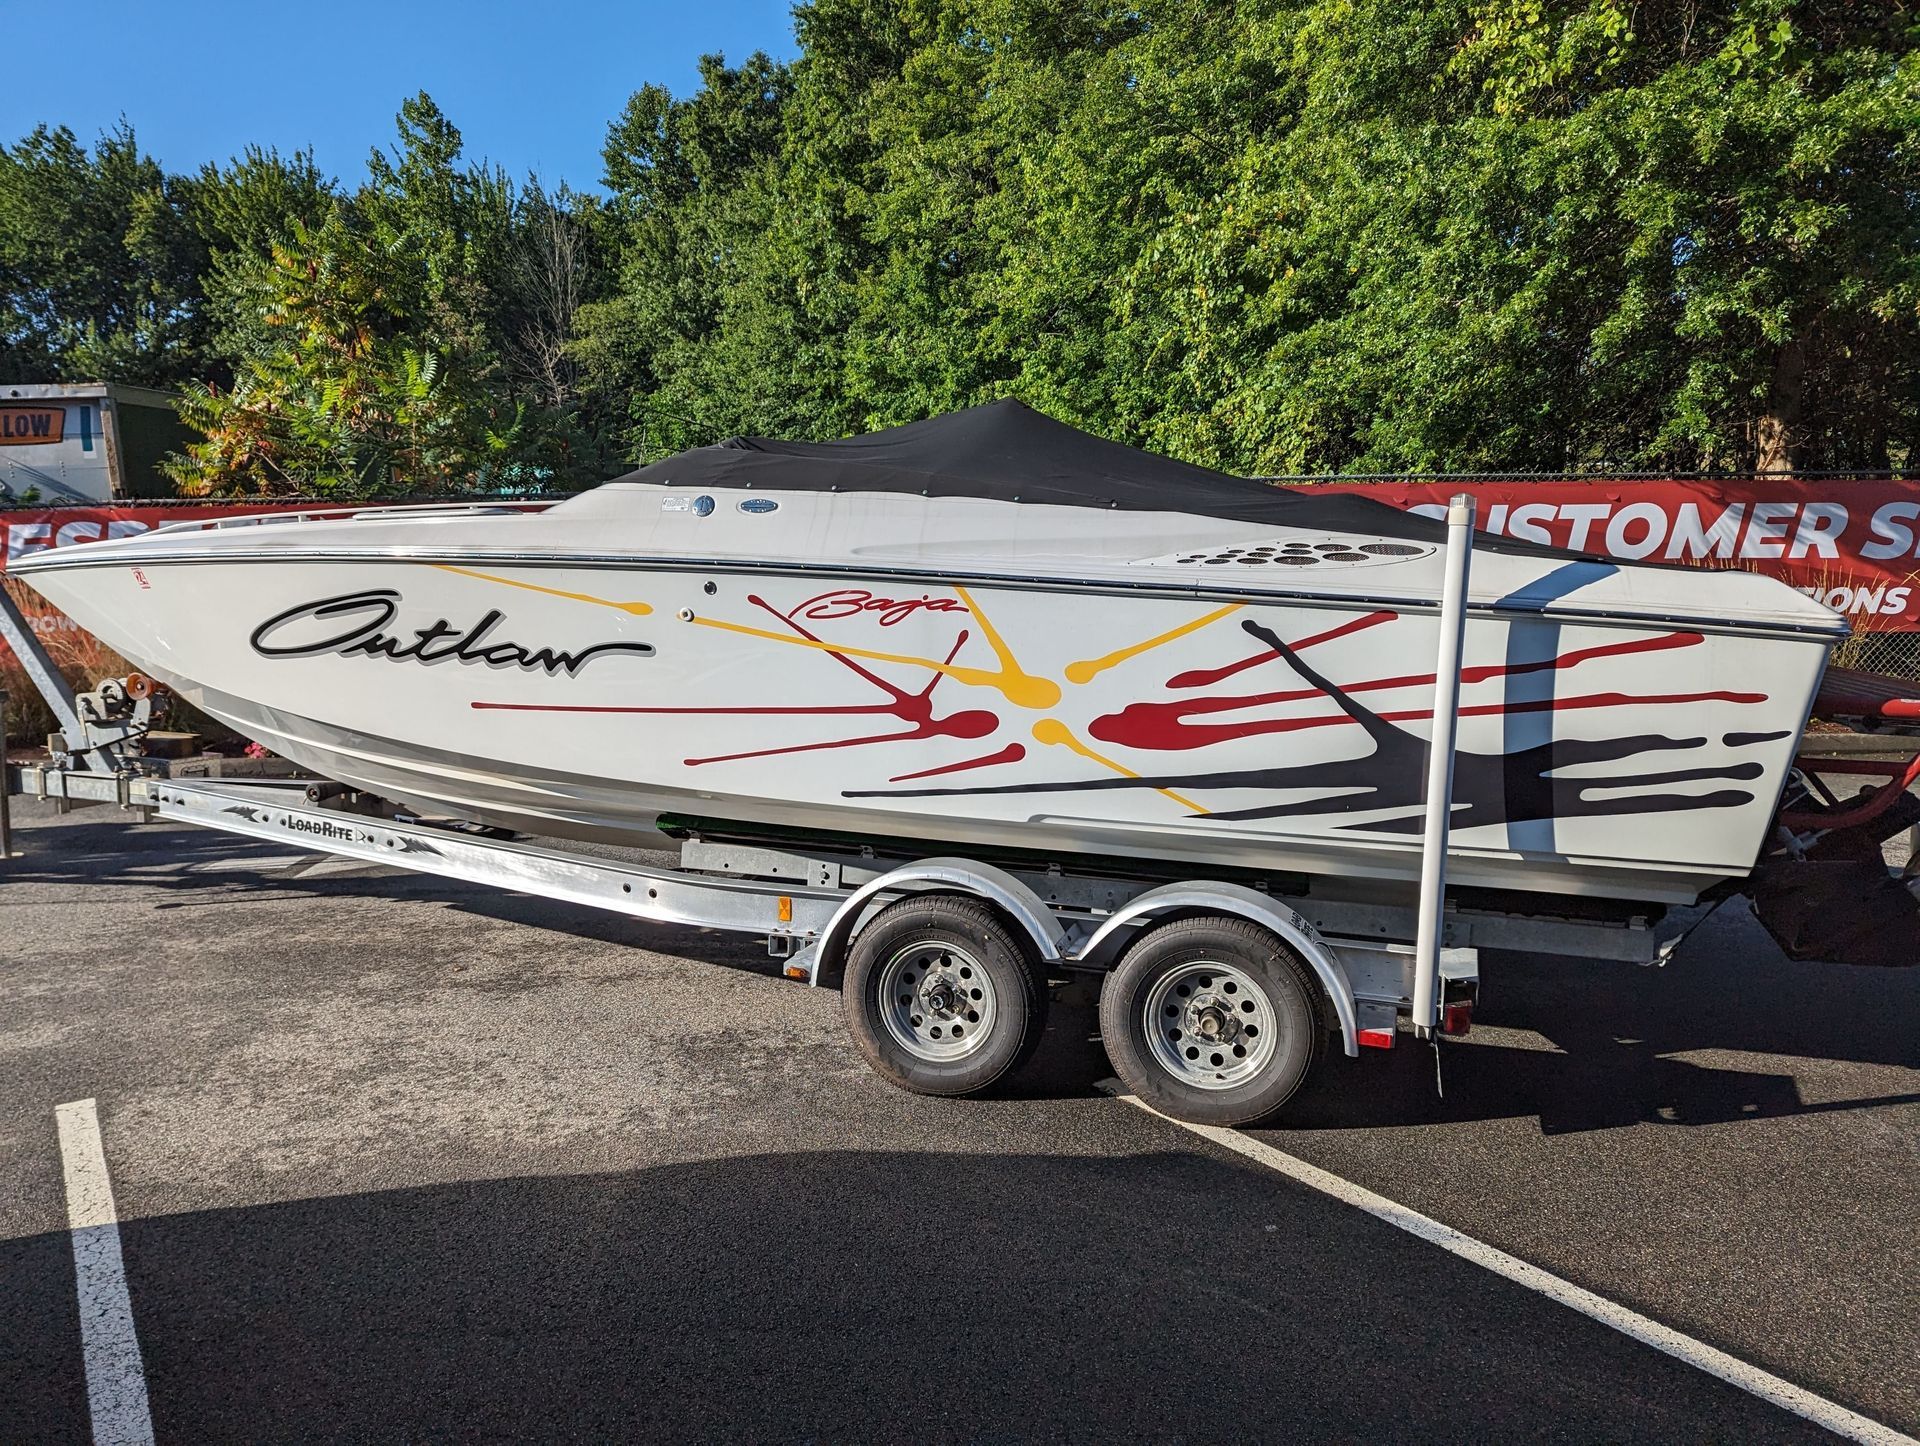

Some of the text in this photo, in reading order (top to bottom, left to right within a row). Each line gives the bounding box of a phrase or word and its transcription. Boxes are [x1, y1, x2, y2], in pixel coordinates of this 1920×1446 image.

[0, 414, 51, 437] LOW
[1408, 501, 1920, 560] STOMER S
[788, 589, 969, 626] Baja
[250, 588, 656, 679] Outlaw
